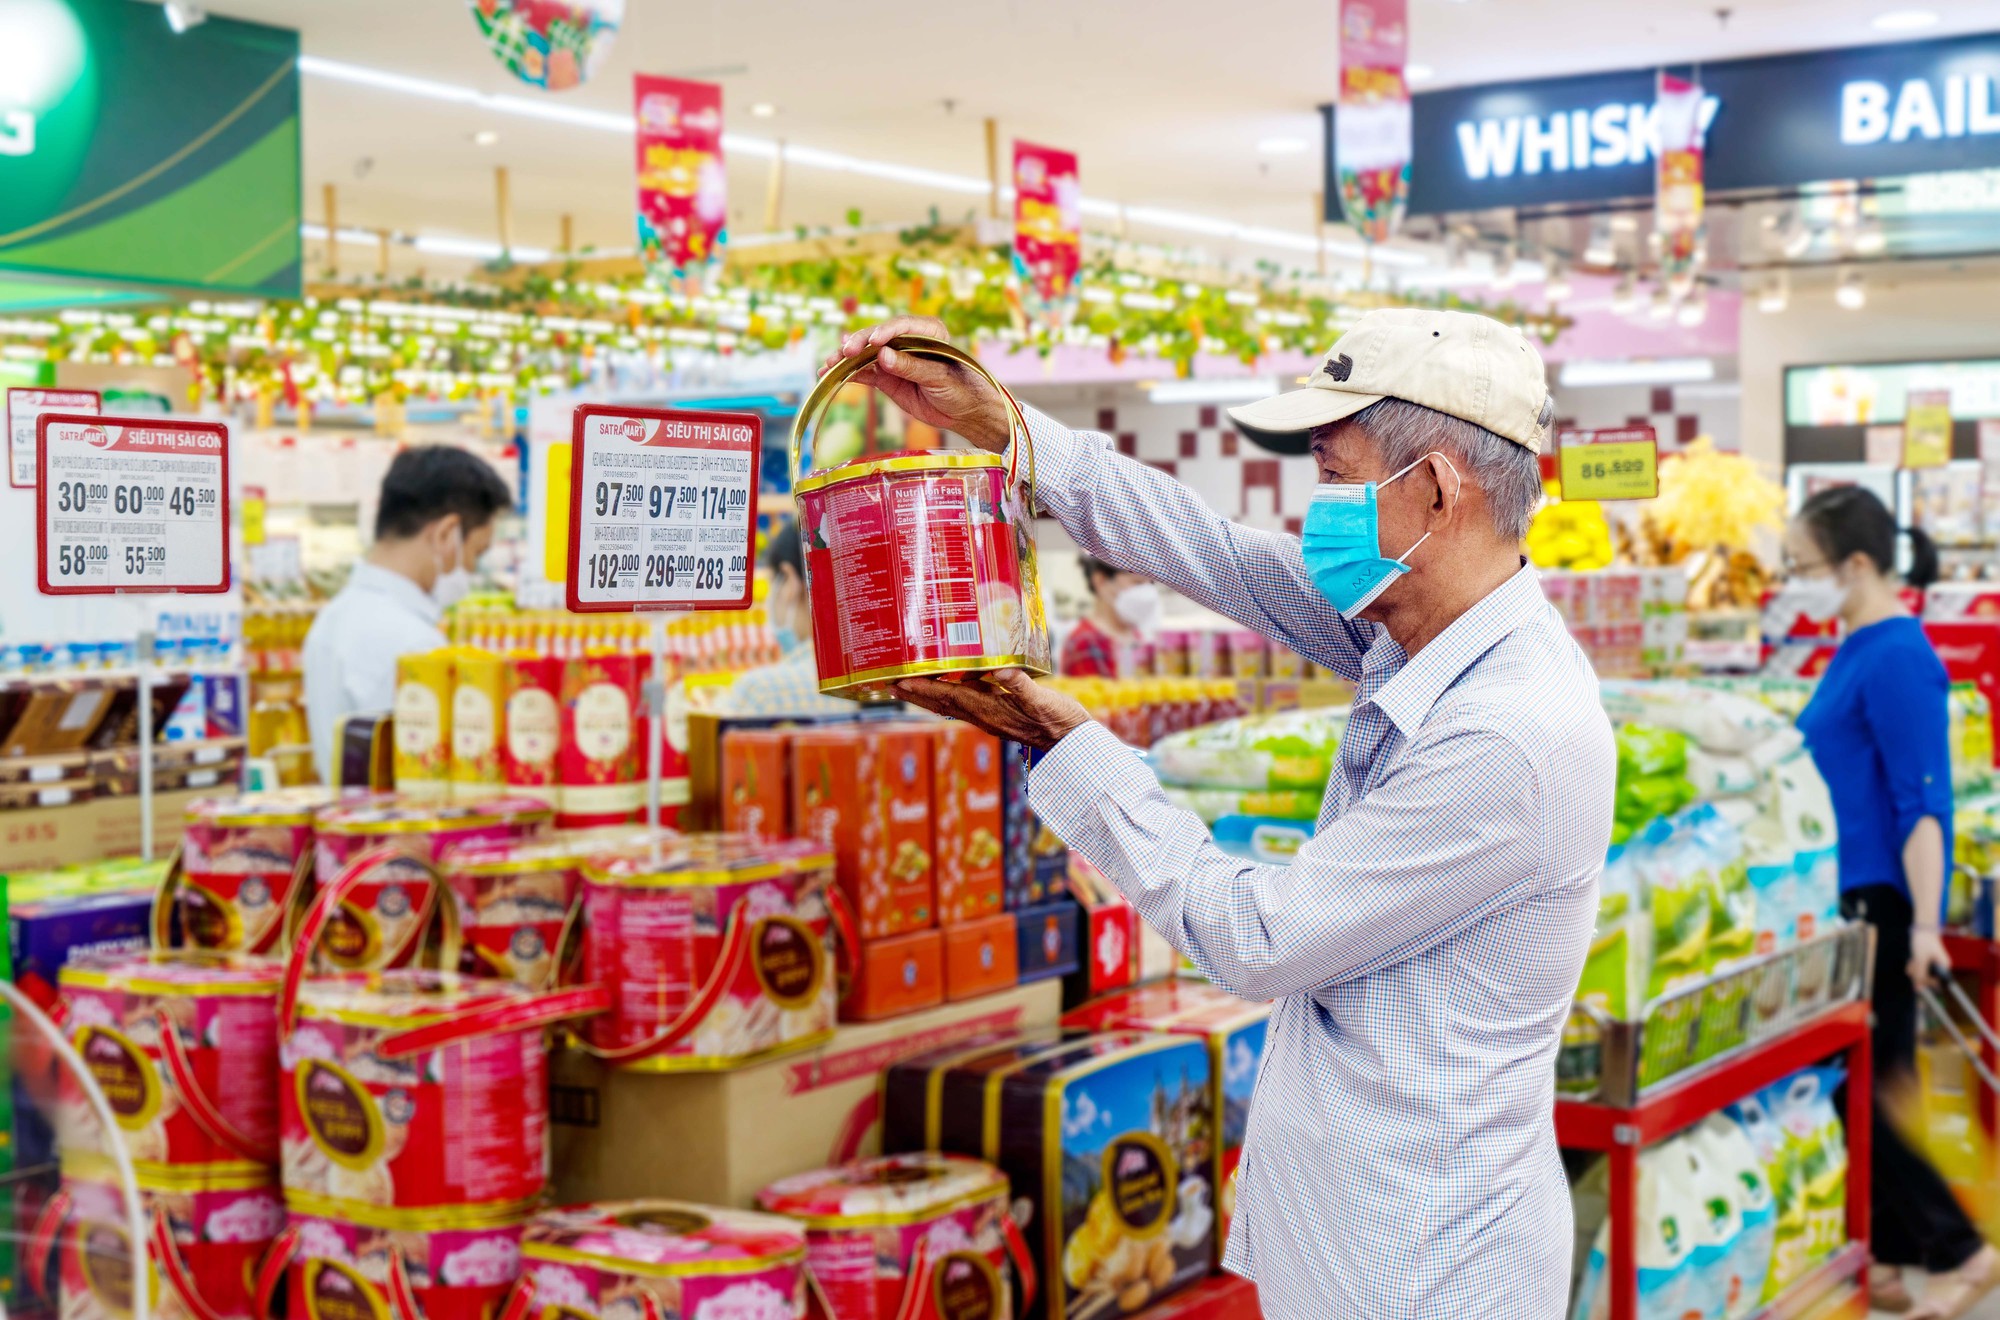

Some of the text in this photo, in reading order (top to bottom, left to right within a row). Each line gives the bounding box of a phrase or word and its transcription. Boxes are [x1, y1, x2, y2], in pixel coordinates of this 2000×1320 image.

[129, 429, 154, 446] SIÊU
[155, 432, 176, 450] THỊ
[177, 433, 195, 447] SÀI
[666, 421, 691, 439] SIÊU
[693, 424, 711, 444] THỊ
[713, 424, 731, 442] SÀI
[895, 487, 939, 498] Nutron
[940, 486, 962, 495] Facts
